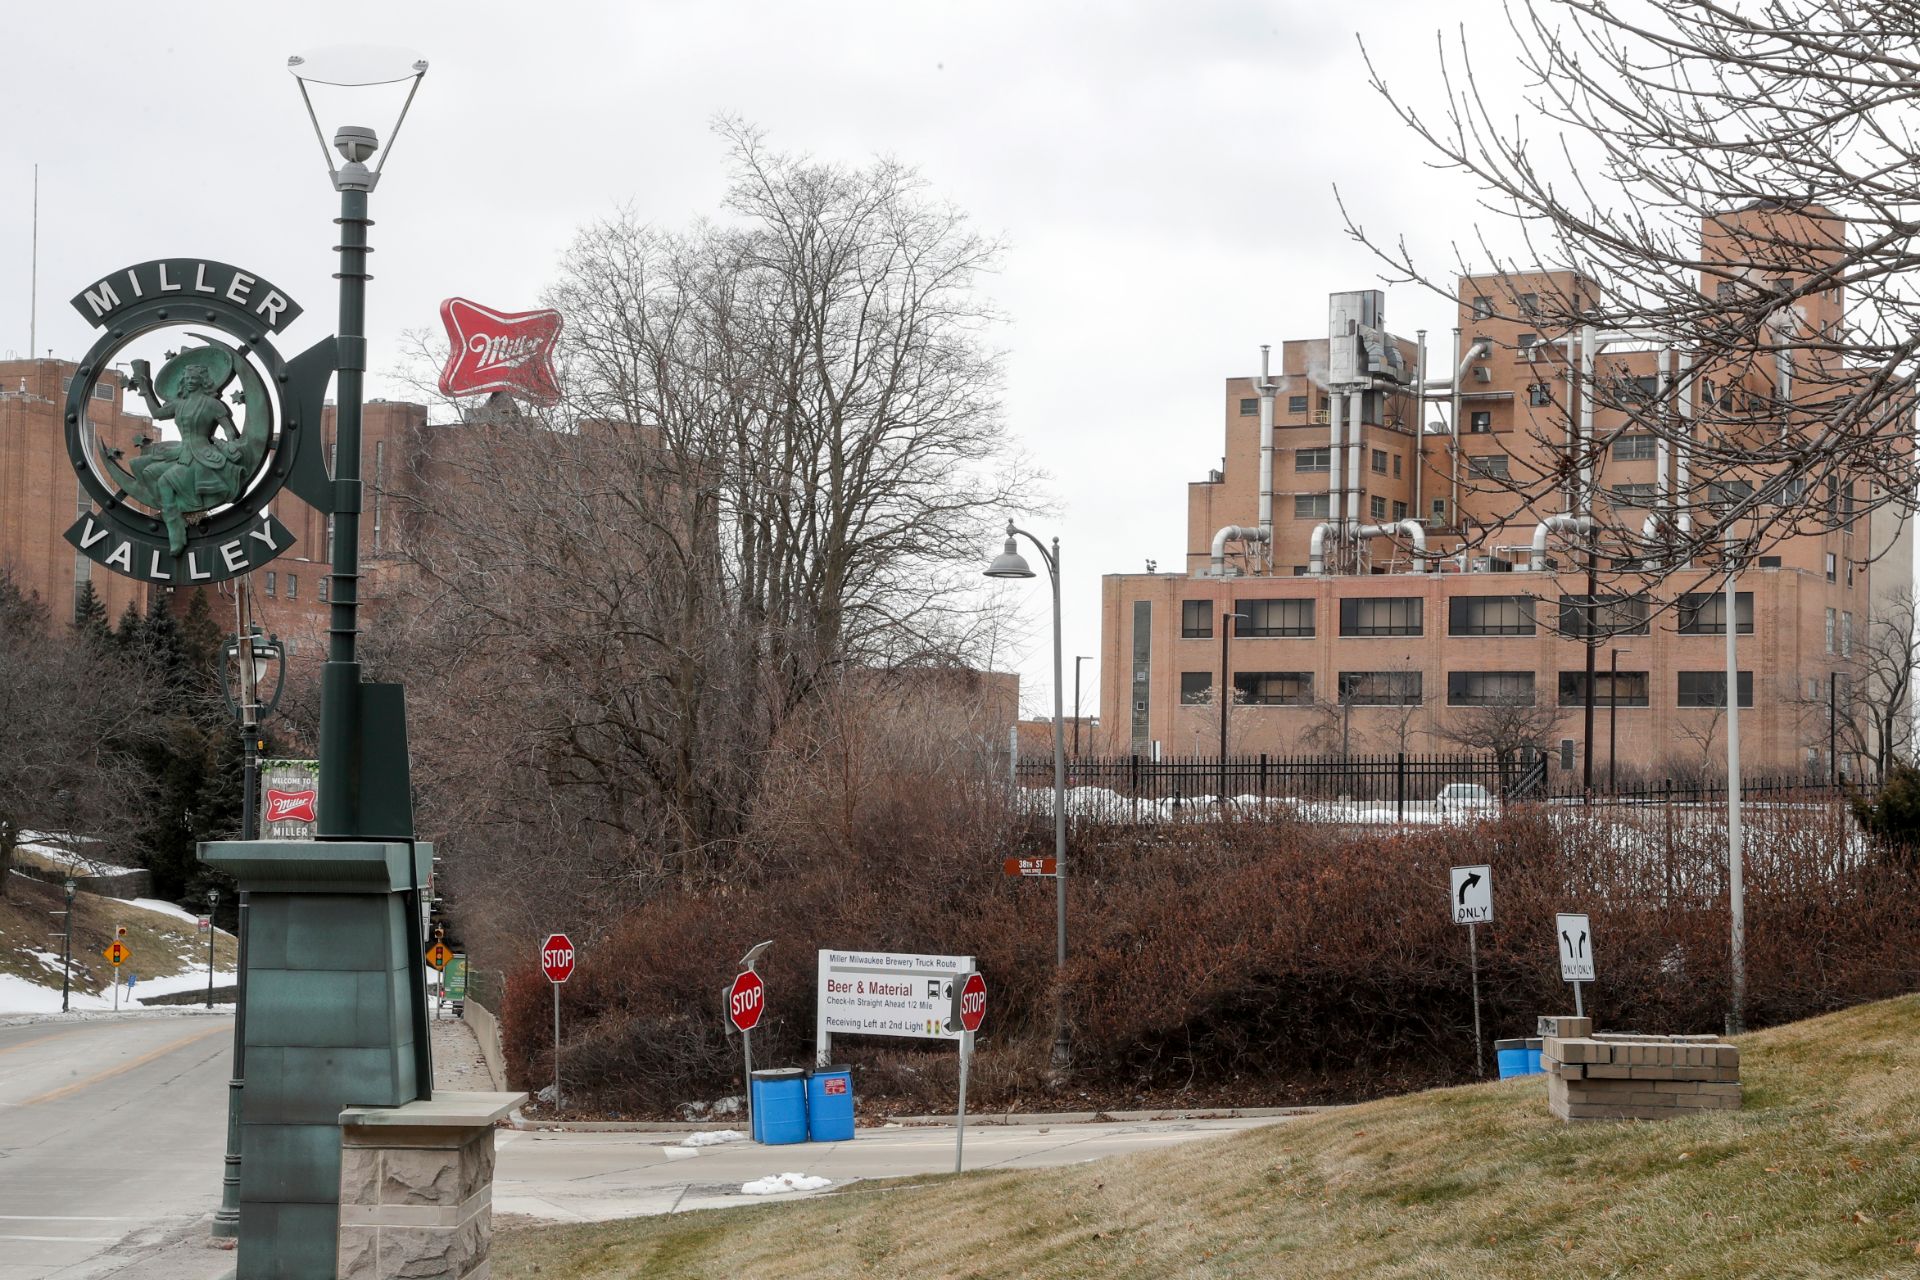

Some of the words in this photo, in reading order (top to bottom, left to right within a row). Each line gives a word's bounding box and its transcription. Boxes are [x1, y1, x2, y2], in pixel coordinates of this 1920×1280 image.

[83, 263, 288, 326] MILLER
[469, 333, 544, 368] Miller
[80, 518, 278, 581] VALLEY
[273, 798, 309, 812] Miller
[273, 827, 308, 837] MILLER
[1036, 860, 1043, 868] ST
[1458, 906, 1488, 920] ONLY
[544, 949, 573, 968] STOP
[829, 954, 848, 963] Miller
[849, 955, 884, 965] Milwaukee
[885, 958, 913, 968] Brewery
[915, 958, 934, 967] Truck
[936, 959, 957, 968] Route
[1563, 964, 1577, 975] ONLY
[1578, 964, 1592, 975] ONLY
[827, 979, 853, 993] Beer
[857, 980, 865, 994] &
[869, 981, 913, 997] Material
[732, 986, 761, 1015] STOP
[857, 998, 882, 1008] Straight
[884, 1000, 906, 1008] Ahead
[919, 1001, 933, 1010] Mile
[962, 991, 985, 1014] STOP
[826, 1016, 861, 1029] Receiving
[863, 1018, 877, 1028] Left
[879, 1020, 887, 1029] at
[888, 1020, 903, 1029] 2nd
[904, 1021, 924, 1032] Light
